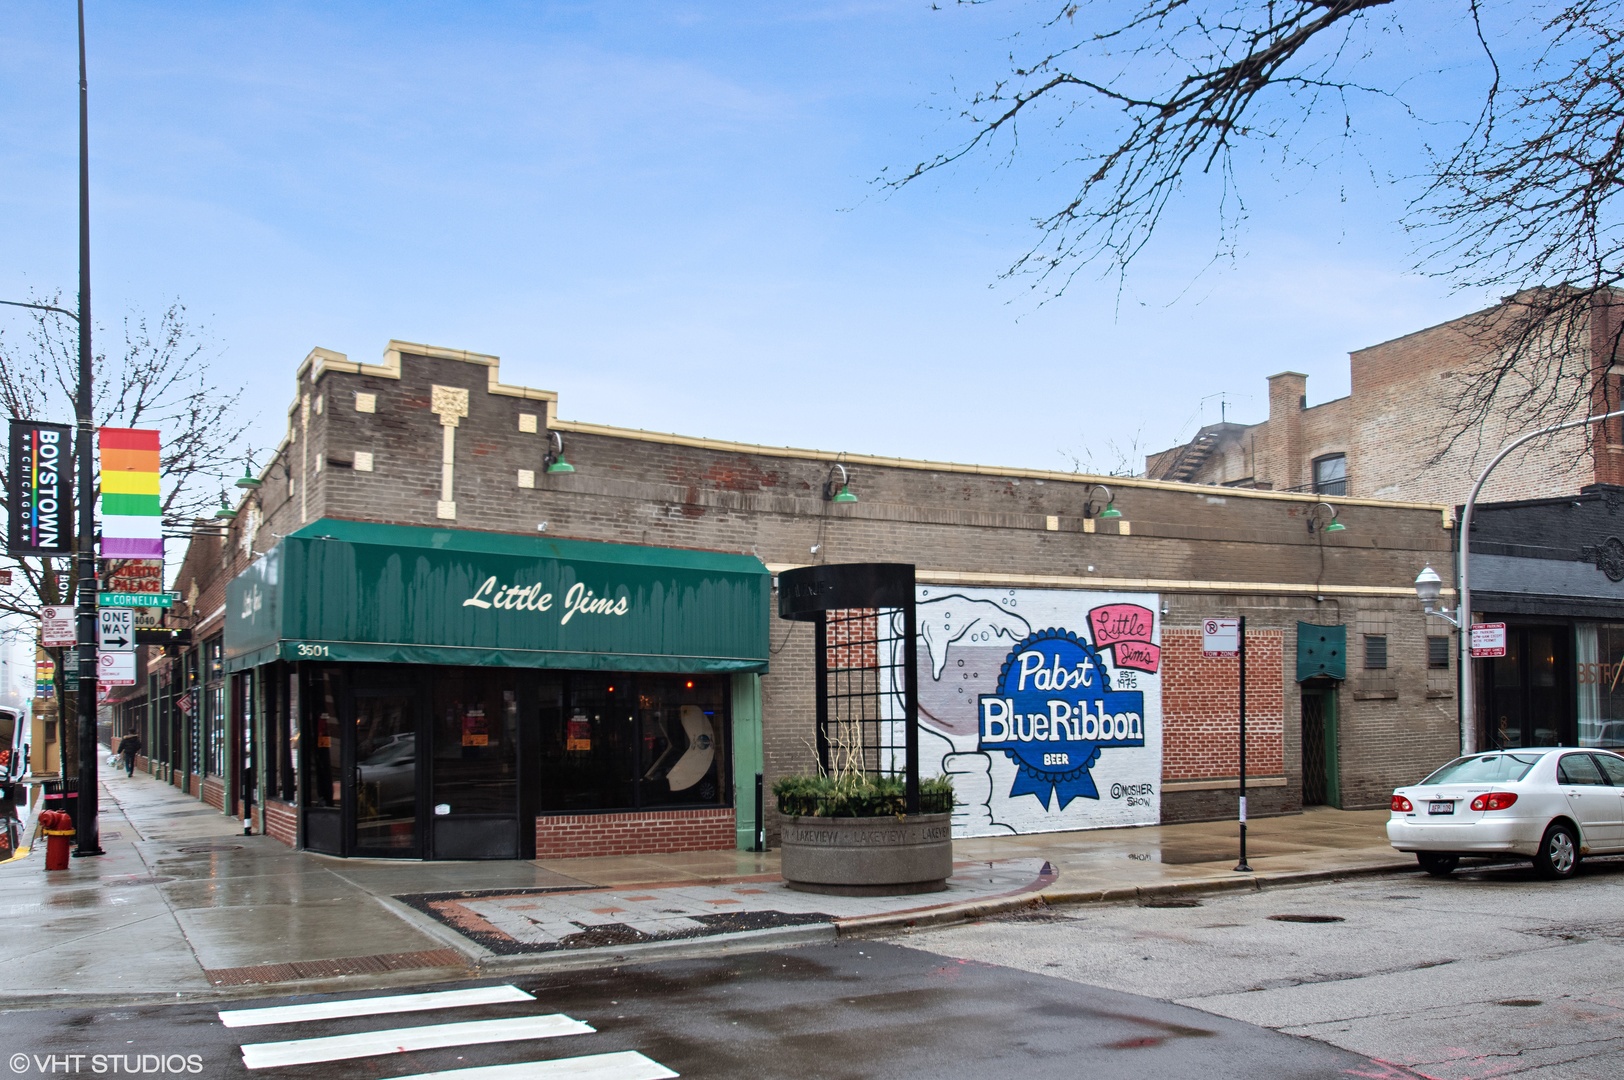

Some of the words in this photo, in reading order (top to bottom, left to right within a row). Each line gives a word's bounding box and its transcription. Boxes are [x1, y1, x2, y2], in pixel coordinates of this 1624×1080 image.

[21, 456, 31, 519] CHICAGO
[38, 430, 60, 548] BOYSTOWN
[113, 579, 160, 592] PALACE
[113, 595, 149, 606] CORNELIA
[462, 575, 553, 612] Little
[561, 582, 629, 626] Jims
[102, 612, 130, 623] ONE
[102, 624, 130, 634] WAY
[1096, 611, 1147, 641] Little
[297, 644, 329, 656] 3501
[1120, 643, 1154, 665] Jim's
[1017, 651, 1094, 691] Pabst
[1119, 671, 1137, 679] EST.
[1117, 678, 1138, 689] 1975
[1043, 753, 1069, 766] BEER
[1110, 782, 1155, 800] @MOSHER
[1126, 796, 1151, 807] SHOW
